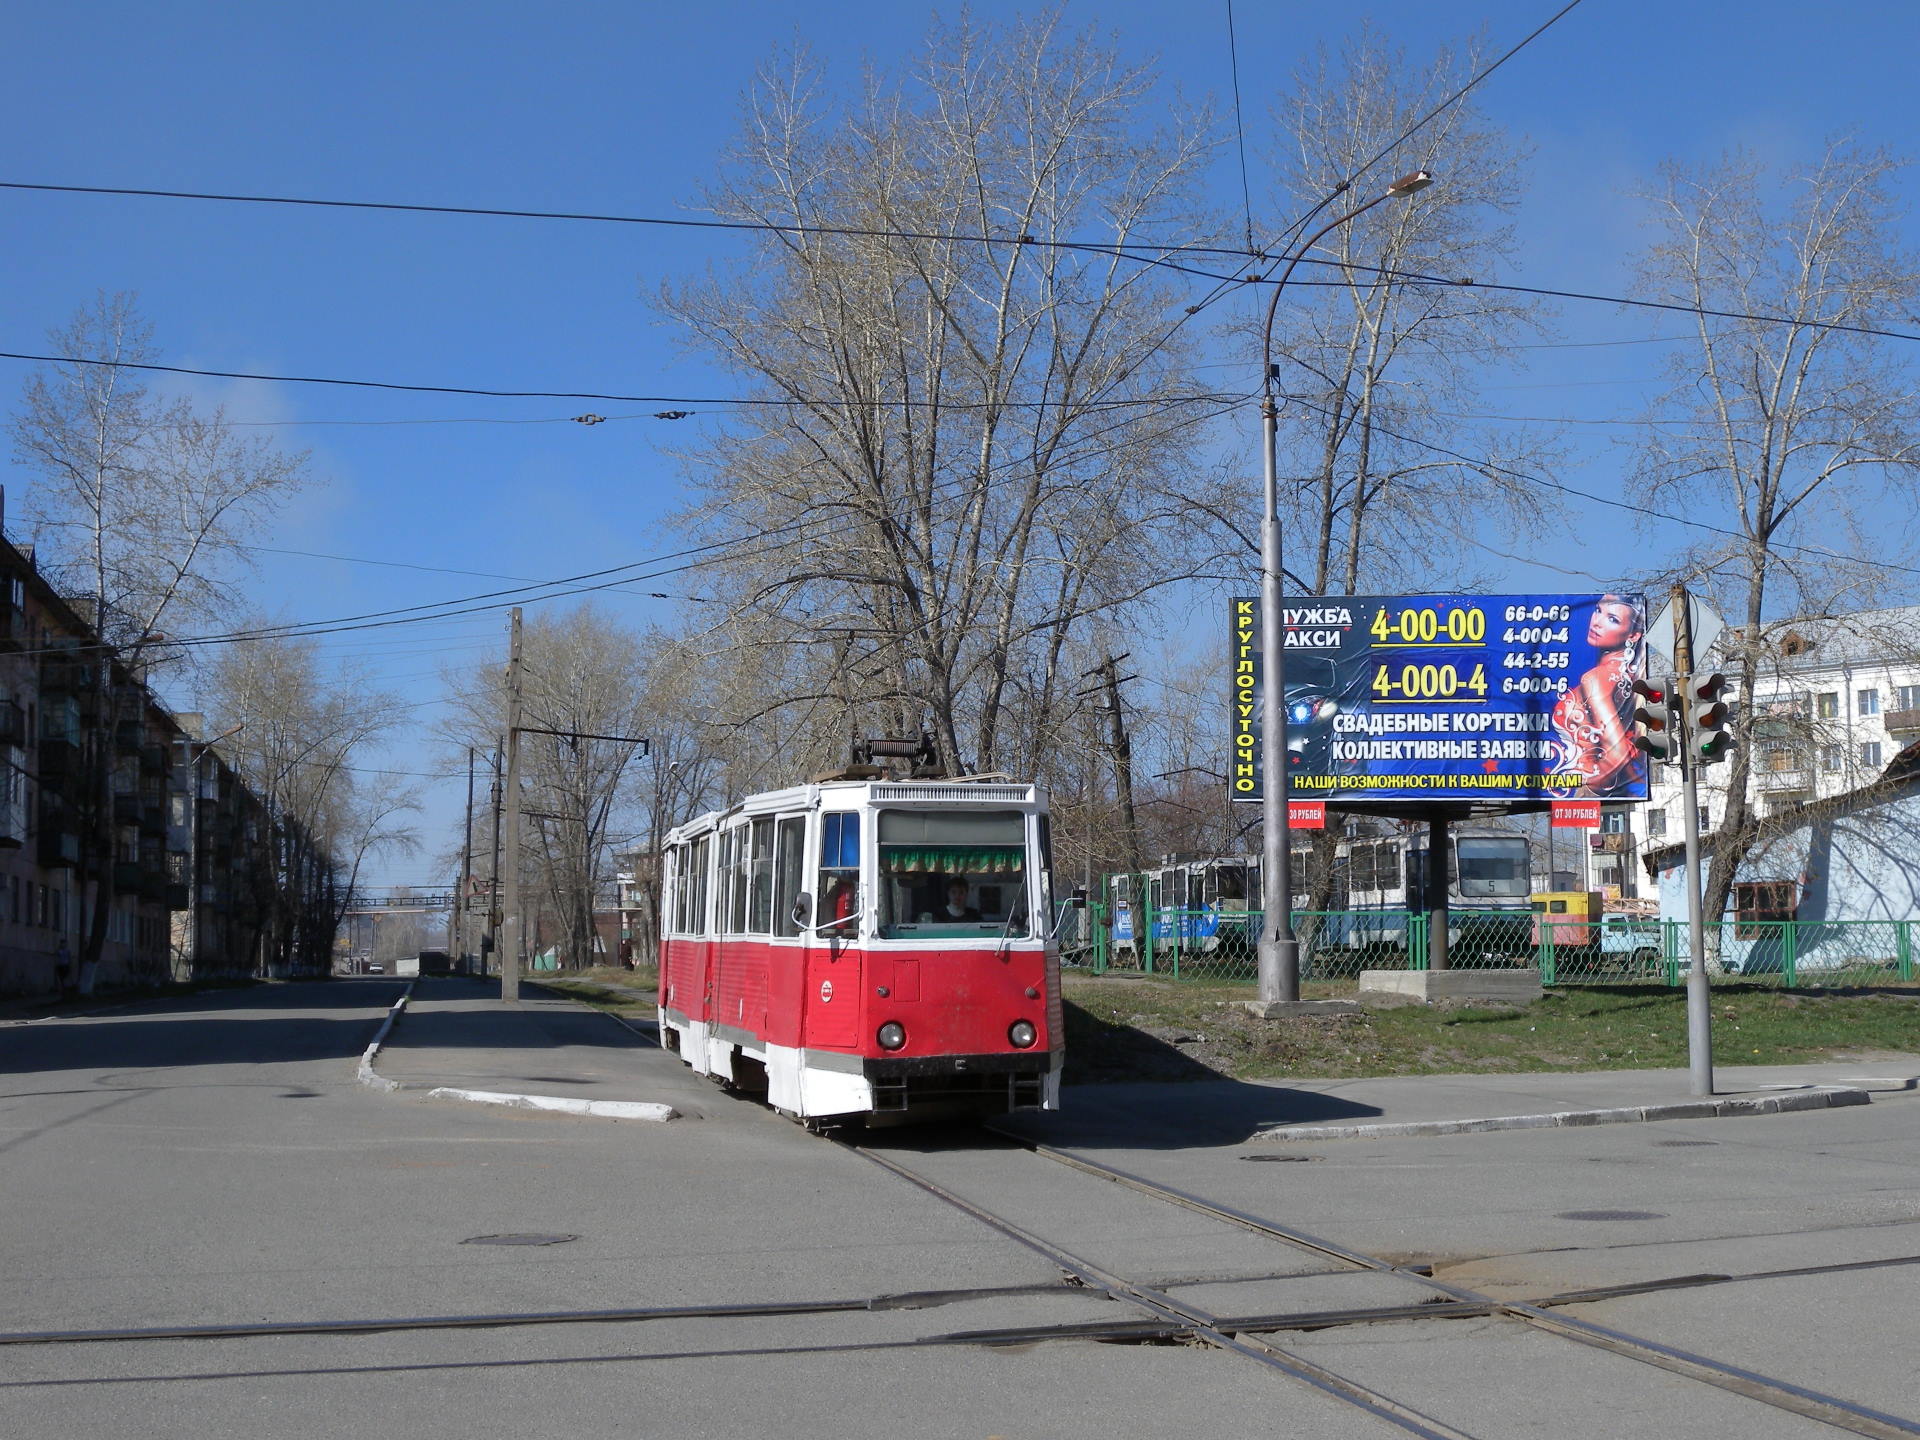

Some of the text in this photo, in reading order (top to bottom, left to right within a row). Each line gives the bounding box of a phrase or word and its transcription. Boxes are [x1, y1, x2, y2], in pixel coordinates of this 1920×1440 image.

[1505, 605, 1570, 622] 66-0-66
[1370, 608, 1486, 641] 4-00-00
[1283, 630, 1341, 647] АКСИ
[1502, 627, 1569, 644] 4-000-4
[1503, 652, 1570, 669] 44-2-55
[1372, 663, 1488, 697] 4-000-4
[1502, 677, 1568, 694] 6-000-6
[1236, 601, 1254, 792] КРУГЛОСУТОЧНО
[1332, 712, 1550, 735] СВАДЕБНЫЕ КОРТЕЖИ
[1332, 740, 1552, 760] КОЛЛЕКТИВНЫЕ ЗАЯВКИ
[1294, 774, 1583, 789] НАШИ ВОЗМОЖНОСТИ К ВАШИМ УСЛУГАМ!
[1289, 807, 1322, 820] 30 РУБЛЕЙ
[1554, 806, 1598, 819] ОТ 30 РУБЛЕЙ
[1488, 880, 1496, 893] 5
